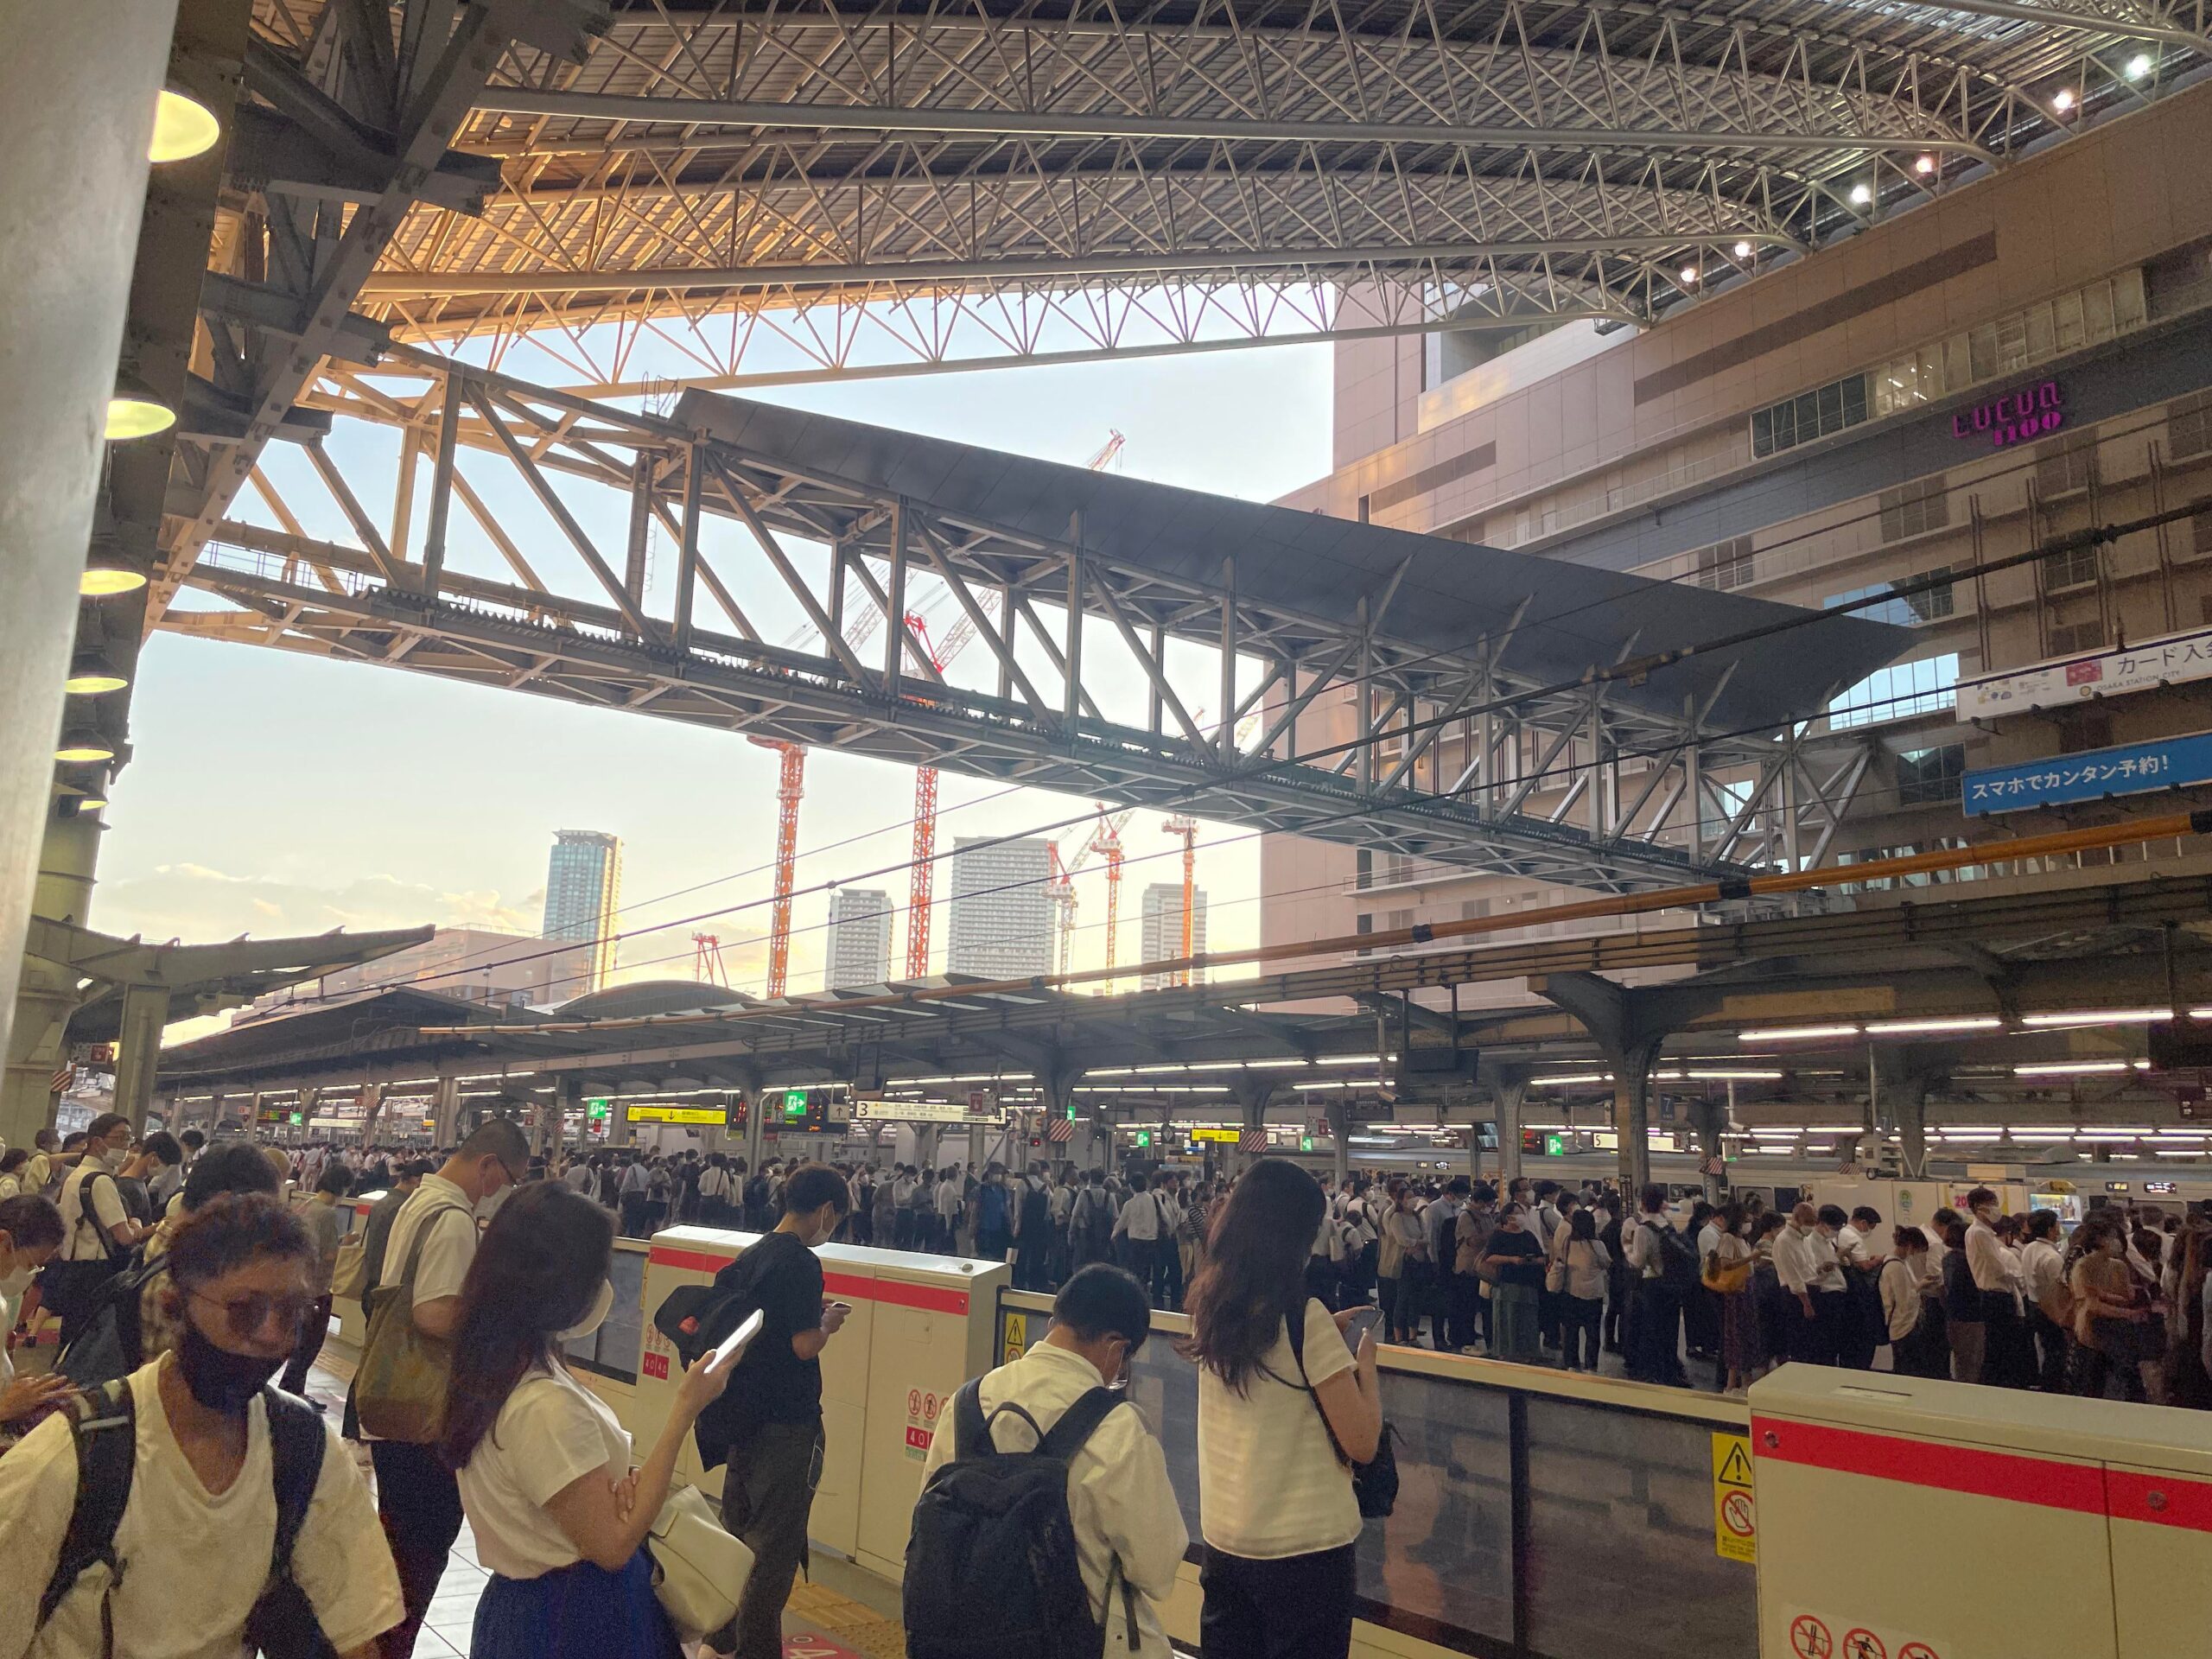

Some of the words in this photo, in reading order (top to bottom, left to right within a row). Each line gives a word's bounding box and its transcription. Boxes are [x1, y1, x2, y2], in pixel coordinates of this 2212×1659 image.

[1952, 382, 2062, 438] LUCUA
[2096, 682, 2123, 691] OSAKA
[2126, 674, 2158, 686] STATION
[2162, 670, 2180, 679] CITY
[1973, 754, 2169, 800] スマホでカンタン予約!
[859, 1103, 868, 1116] 3
[1595, 1135, 1601, 1147] 5
